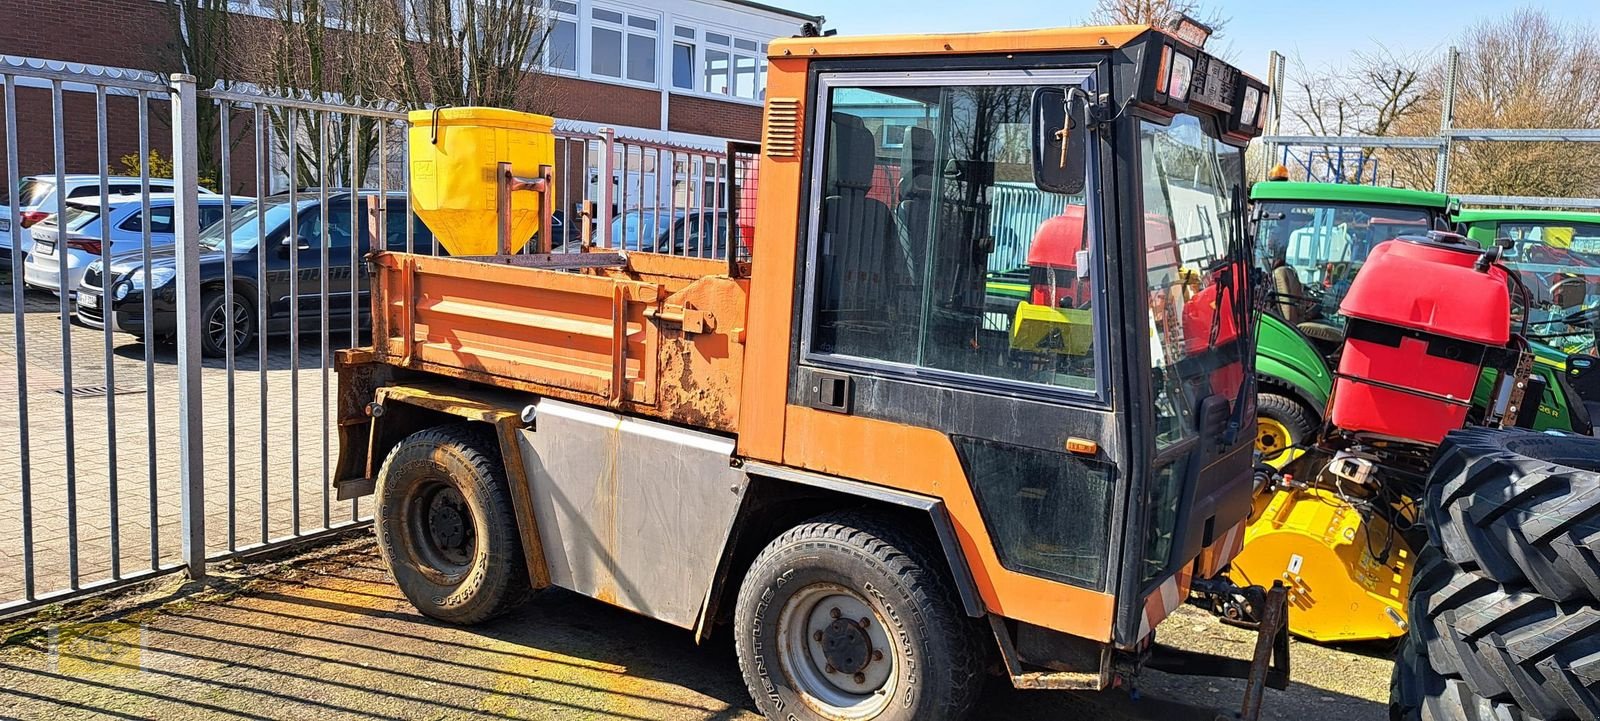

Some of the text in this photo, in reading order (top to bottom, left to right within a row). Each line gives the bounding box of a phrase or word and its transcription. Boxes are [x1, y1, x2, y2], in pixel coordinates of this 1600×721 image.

[431, 551, 488, 607] KUMHO
[752, 568, 794, 713] VENTURE AT
[863, 581, 917, 709] KUMHO
